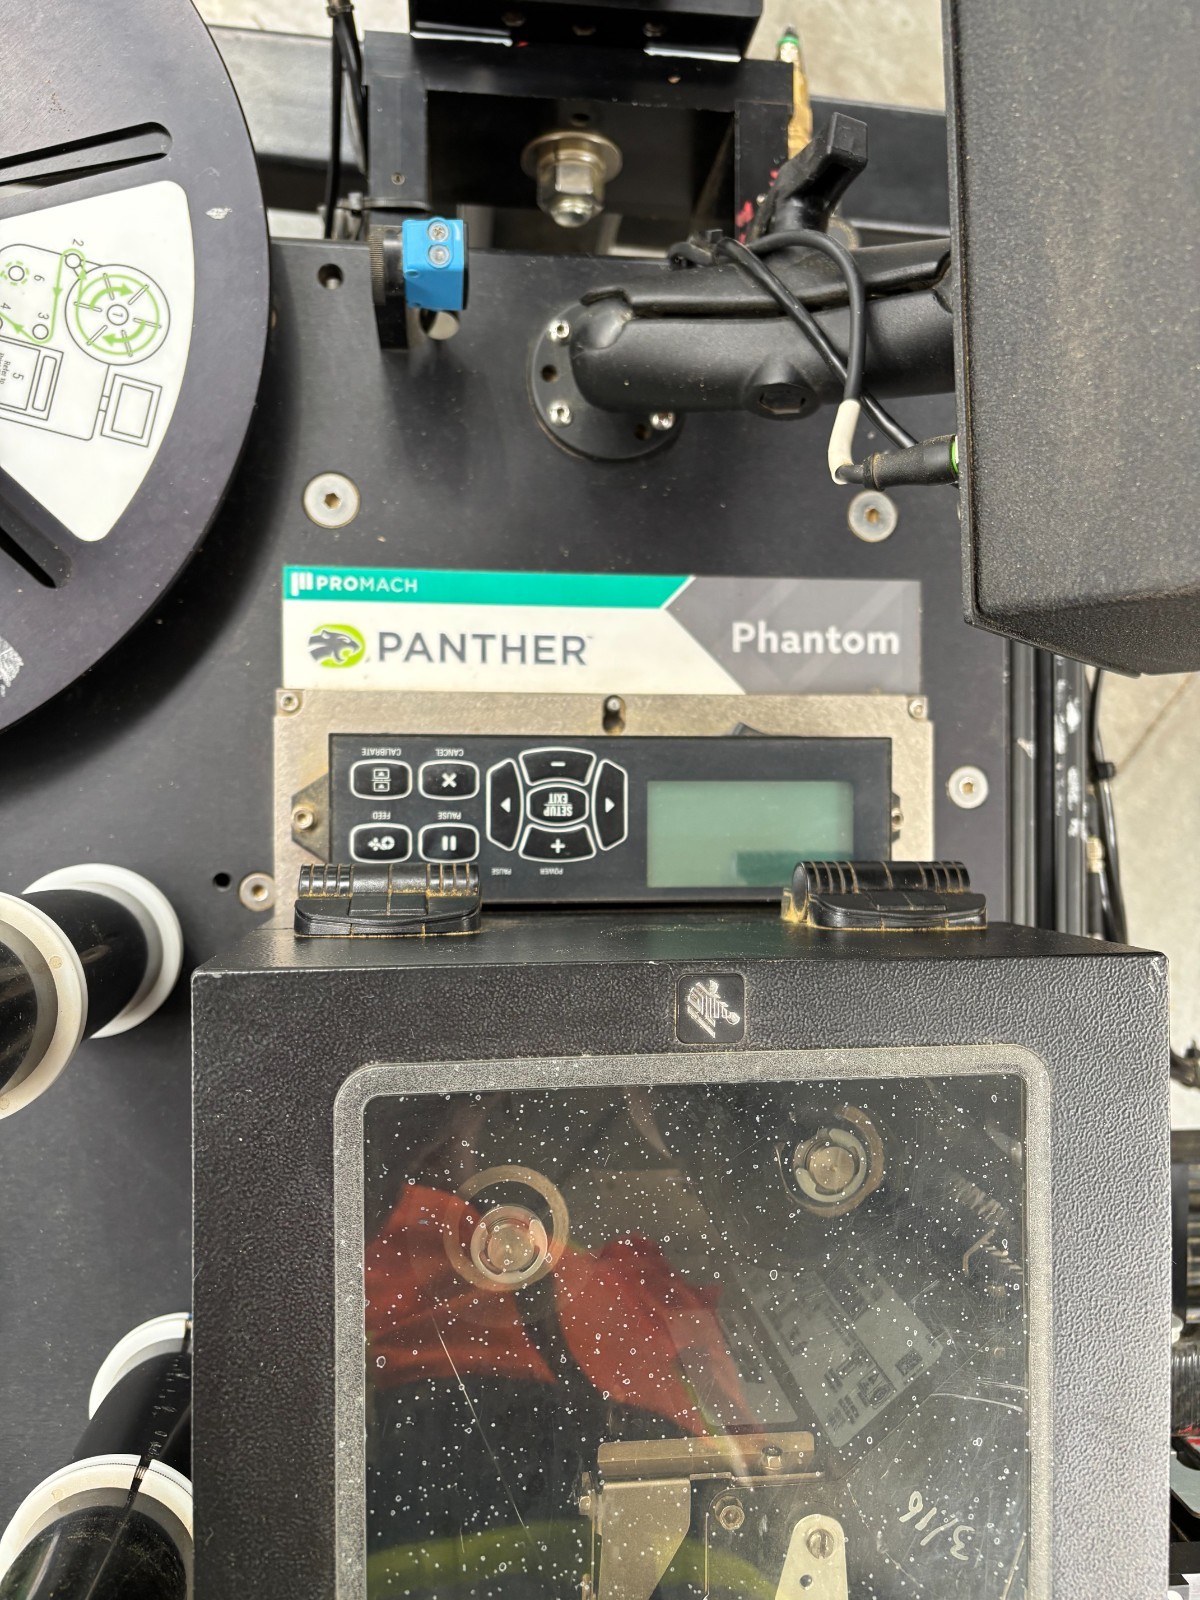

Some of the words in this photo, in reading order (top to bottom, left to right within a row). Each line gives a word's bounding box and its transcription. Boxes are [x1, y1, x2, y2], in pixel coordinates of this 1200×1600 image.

[72, 238, 85, 247] 2
[0, 302, 12, 310] 4
[37, 312, 50, 321] 3
[12, 372, 25, 381] 5
[316, 575, 419, 593] PROMACH
[732, 619, 900, 655] Phantom
[378, 631, 587, 666] PANTHER
[361, 747, 402, 756] CALIBRATE
[435, 748, 465, 757] CANCEL
[549, 792, 569, 804] EXIT
[543, 804, 573, 817] SETUP
[372, 811, 391, 820] FEED
[437, 811, 462, 820] PAUSE
[491, 867, 512, 876] PAUSE
[540, 867, 564, 876] POWER
